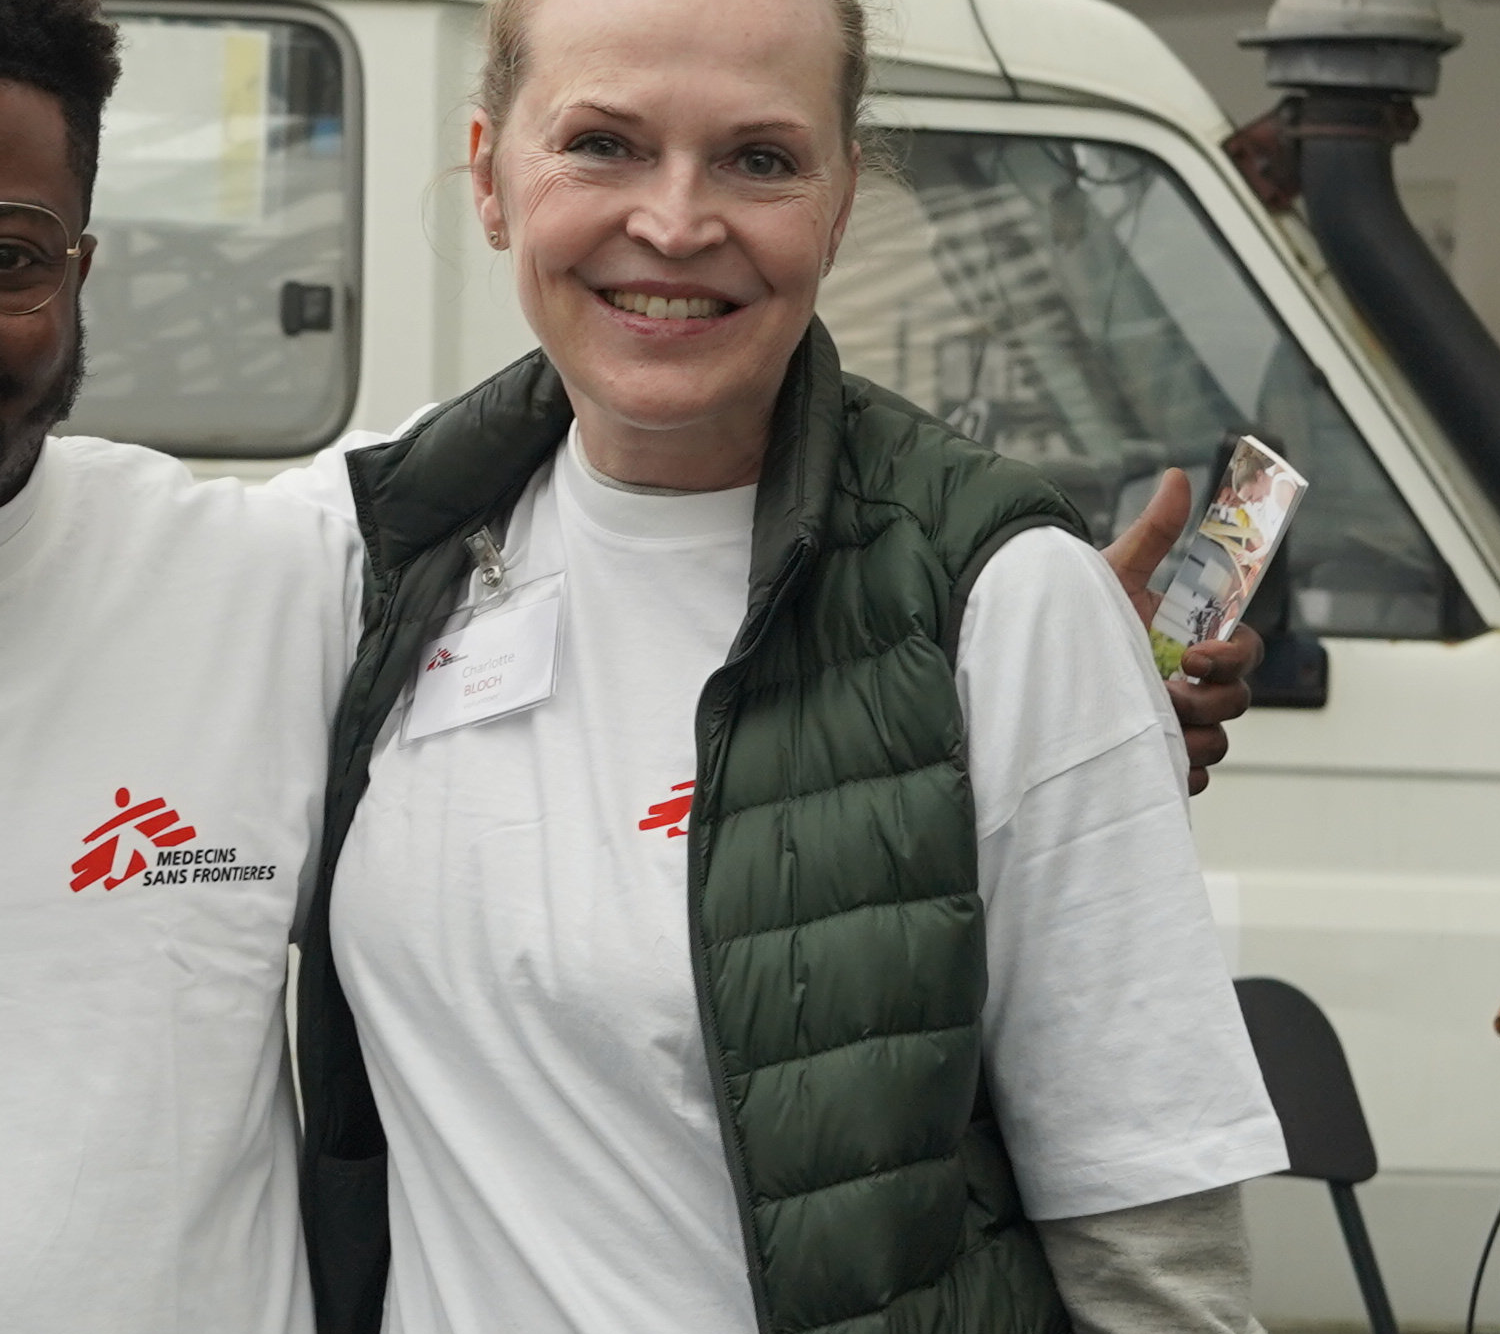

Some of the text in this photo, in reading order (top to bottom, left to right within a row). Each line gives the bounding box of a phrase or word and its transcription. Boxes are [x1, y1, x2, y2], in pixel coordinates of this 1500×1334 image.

[463, 653, 515, 679] Charlotte
[464, 674, 502, 697] BLOCH
[156, 848, 236, 867] MEDECINS
[142, 865, 277, 887] SANS FRONTIERES
